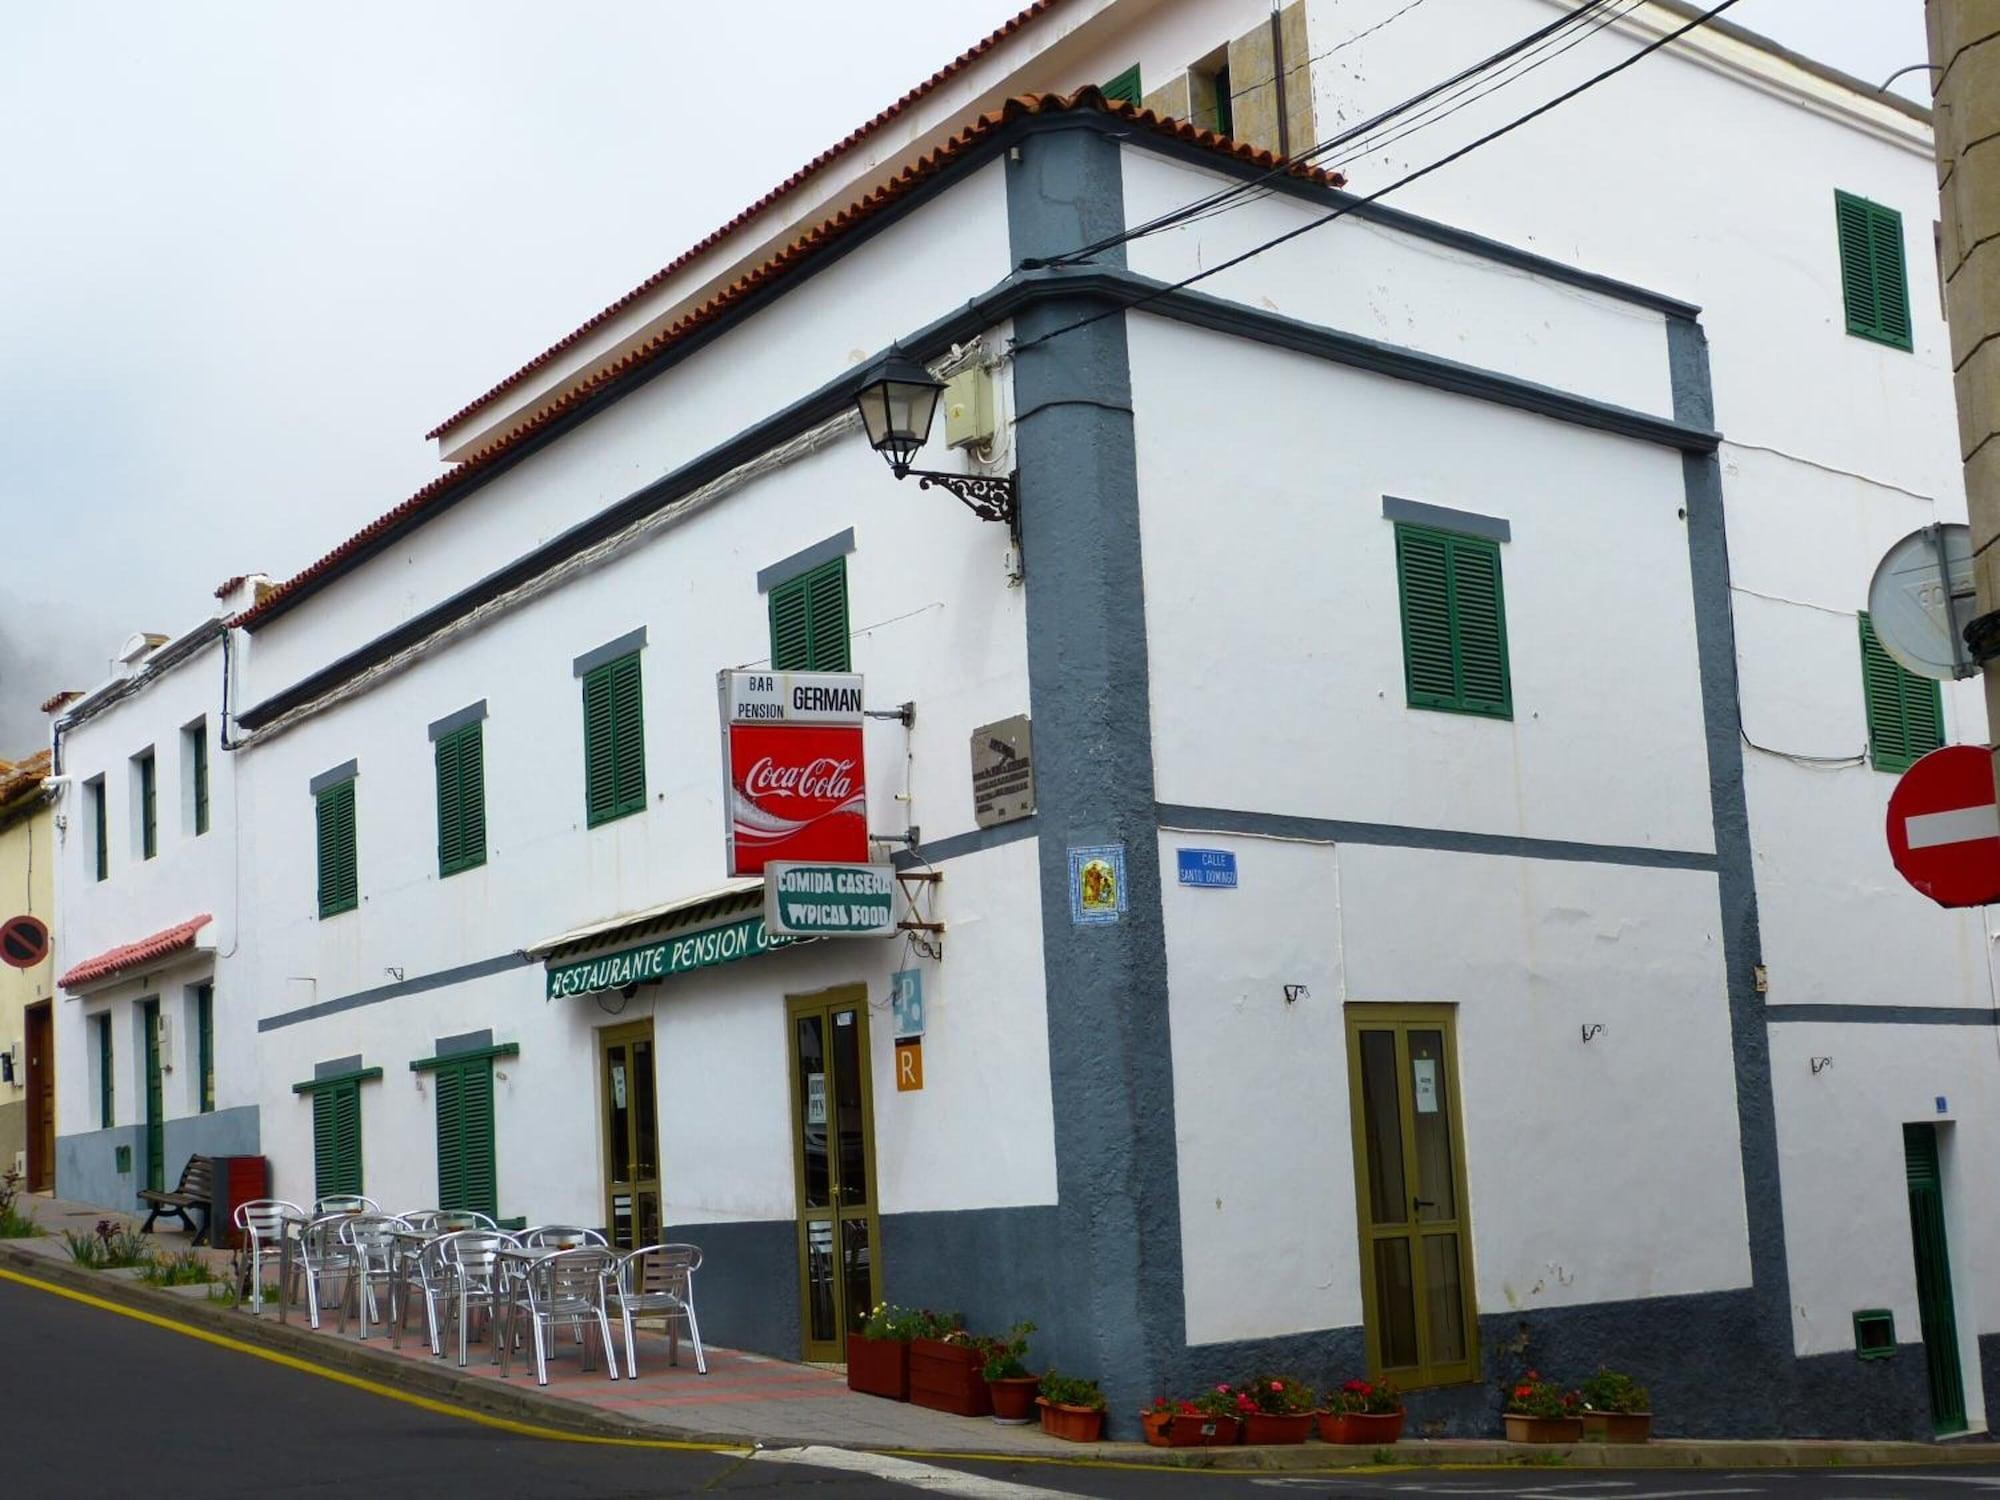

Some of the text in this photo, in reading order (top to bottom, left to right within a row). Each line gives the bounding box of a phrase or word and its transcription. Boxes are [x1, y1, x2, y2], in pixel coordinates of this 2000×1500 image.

[749, 676, 773, 692] BAR
[793, 686, 861, 712] GERMAN
[738, 703, 784, 718] PENSION
[745, 757, 856, 797] Coca-Cola
[1201, 853, 1226, 867] CALLE
[778, 872, 891, 894] COMIDA CASERA
[1180, 868, 1237, 884] SANTO DOMINGO
[850, 905, 889, 925] FOOD
[552, 946, 666, 996] RESTAURANTE
[671, 924, 750, 969] PENSION
[902, 978, 914, 1011] P
[901, 1051, 916, 1085] R
